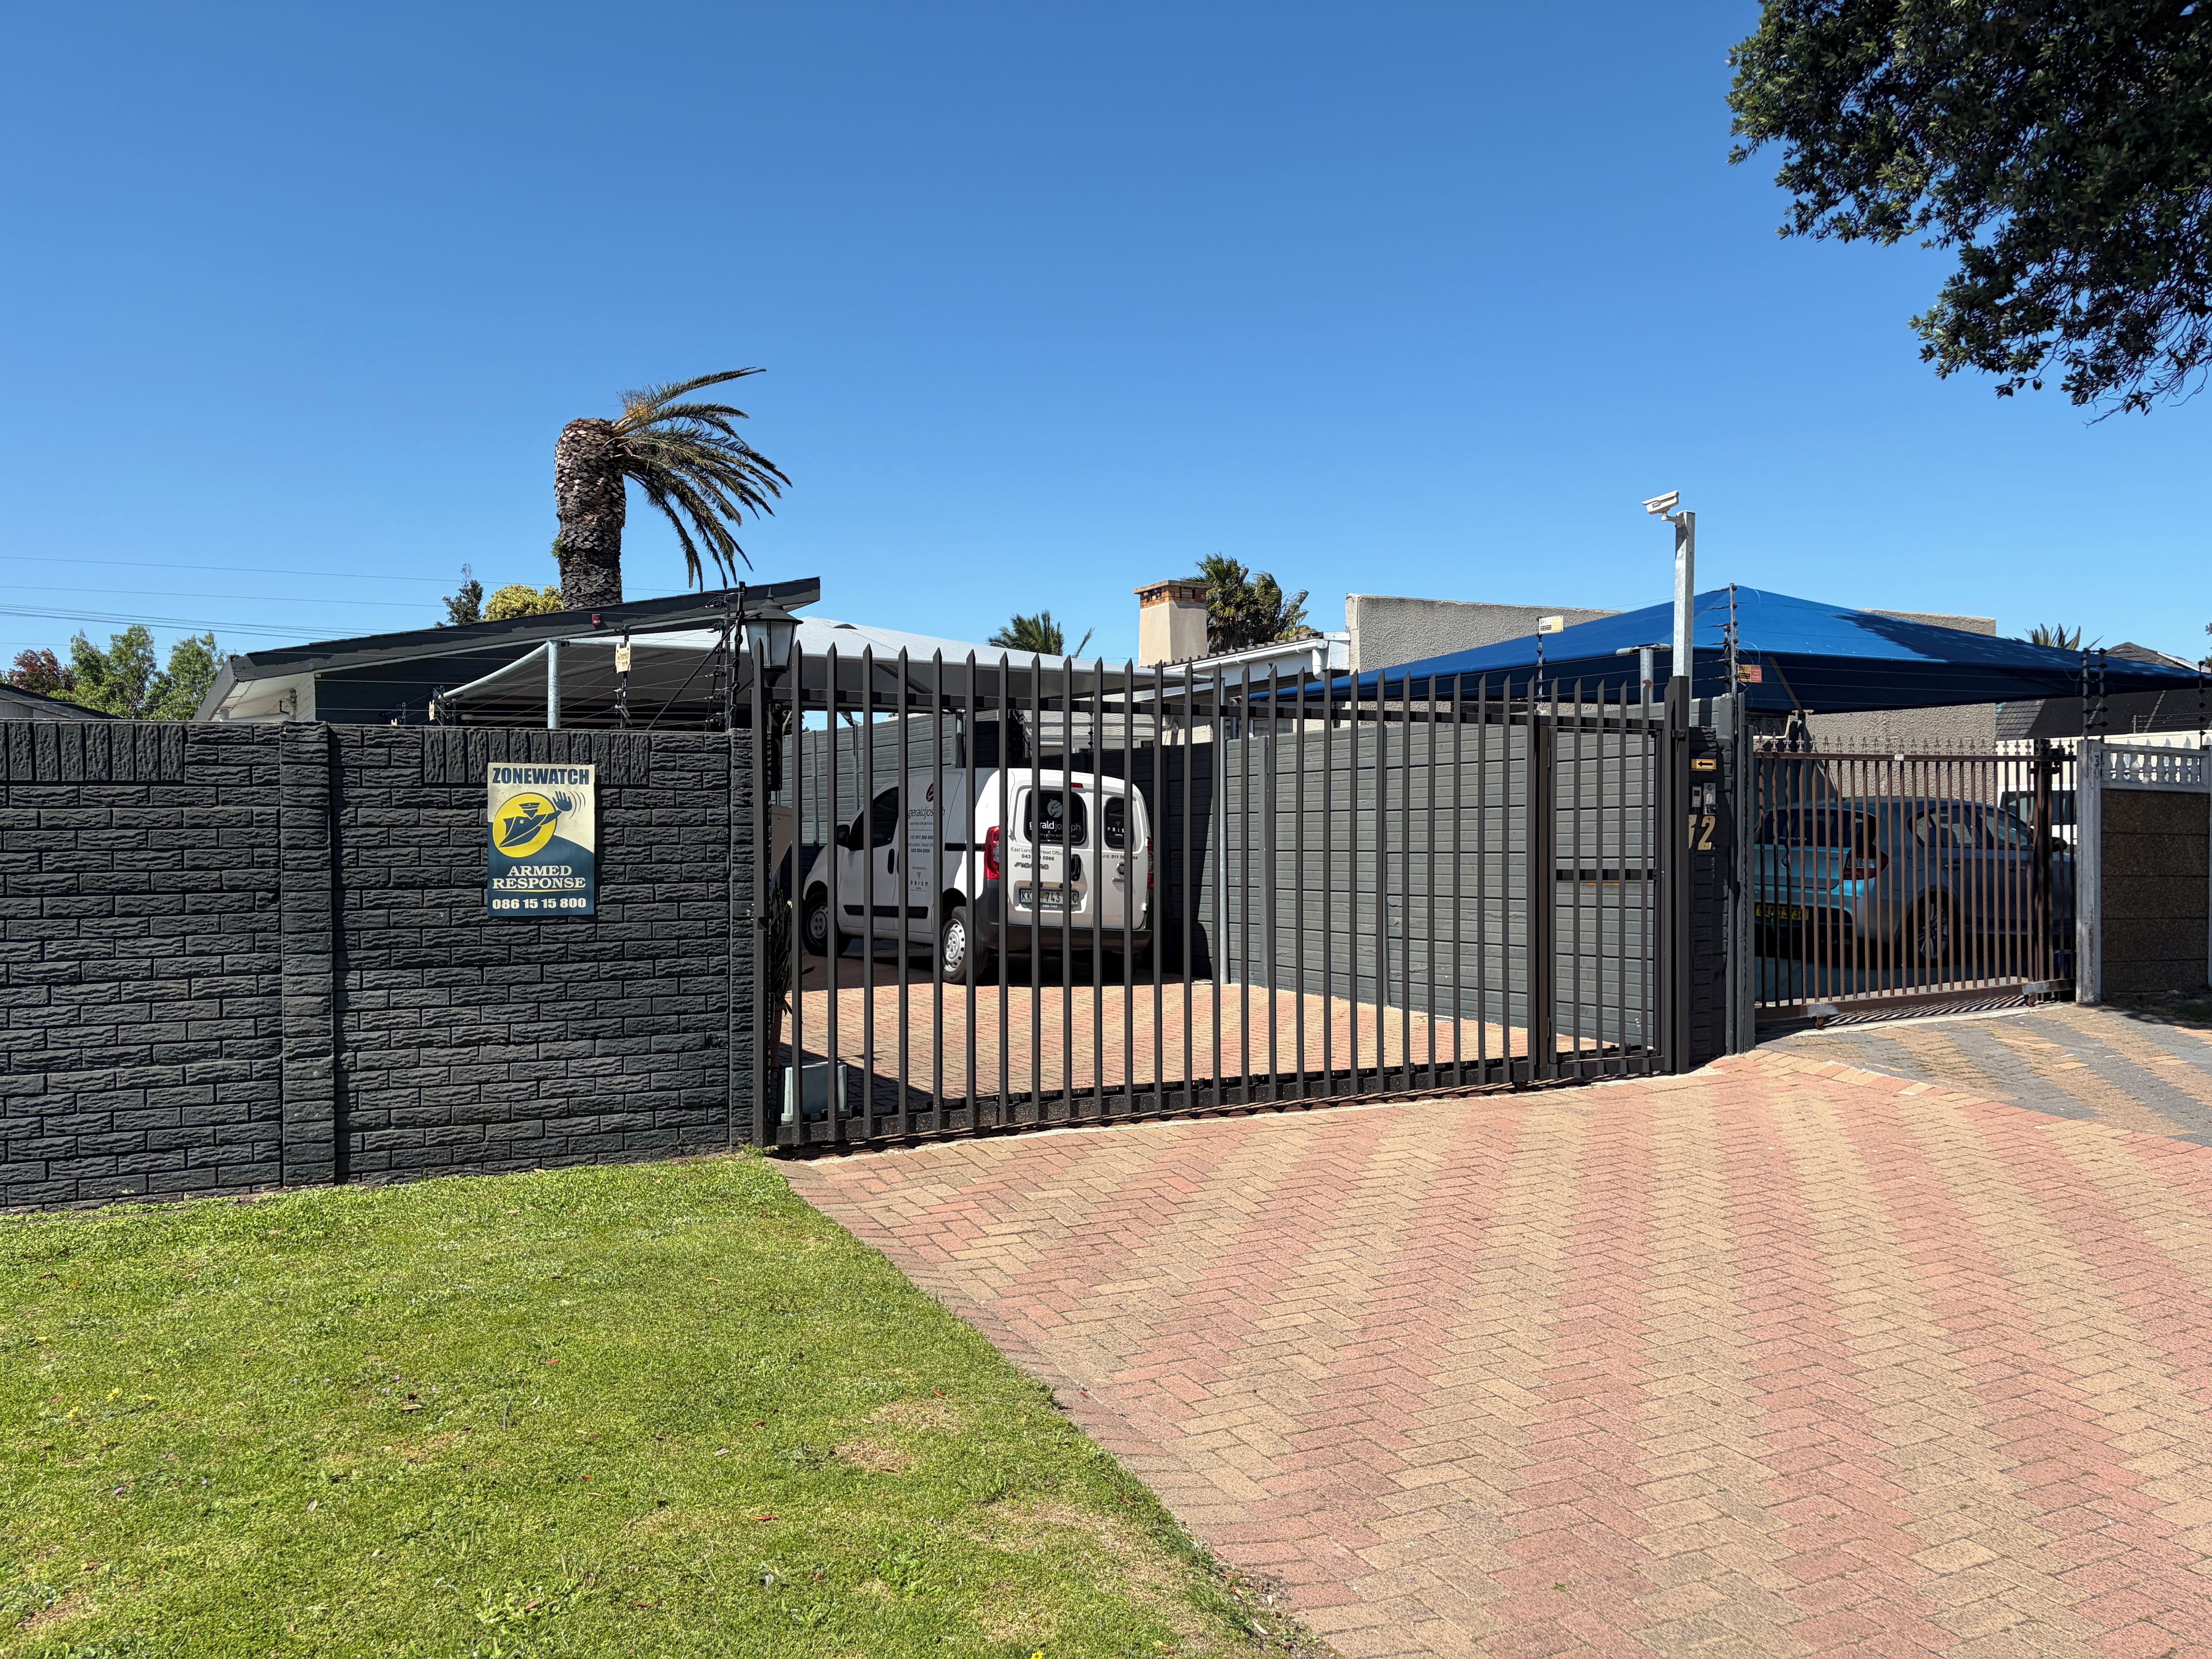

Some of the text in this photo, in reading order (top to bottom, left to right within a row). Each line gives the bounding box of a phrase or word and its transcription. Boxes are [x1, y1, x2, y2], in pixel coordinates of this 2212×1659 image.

[493, 768, 589, 785] ZONEWATCH
[908, 806, 945, 819] geraldjosh
[1029, 820, 1081, 832] graldjoph
[507, 866, 572, 876] ARMED
[493, 877, 586, 889] RESPONSE
[493, 898, 586, 909] 086 15 15 800
[1046, 892, 1060, 903] 743
